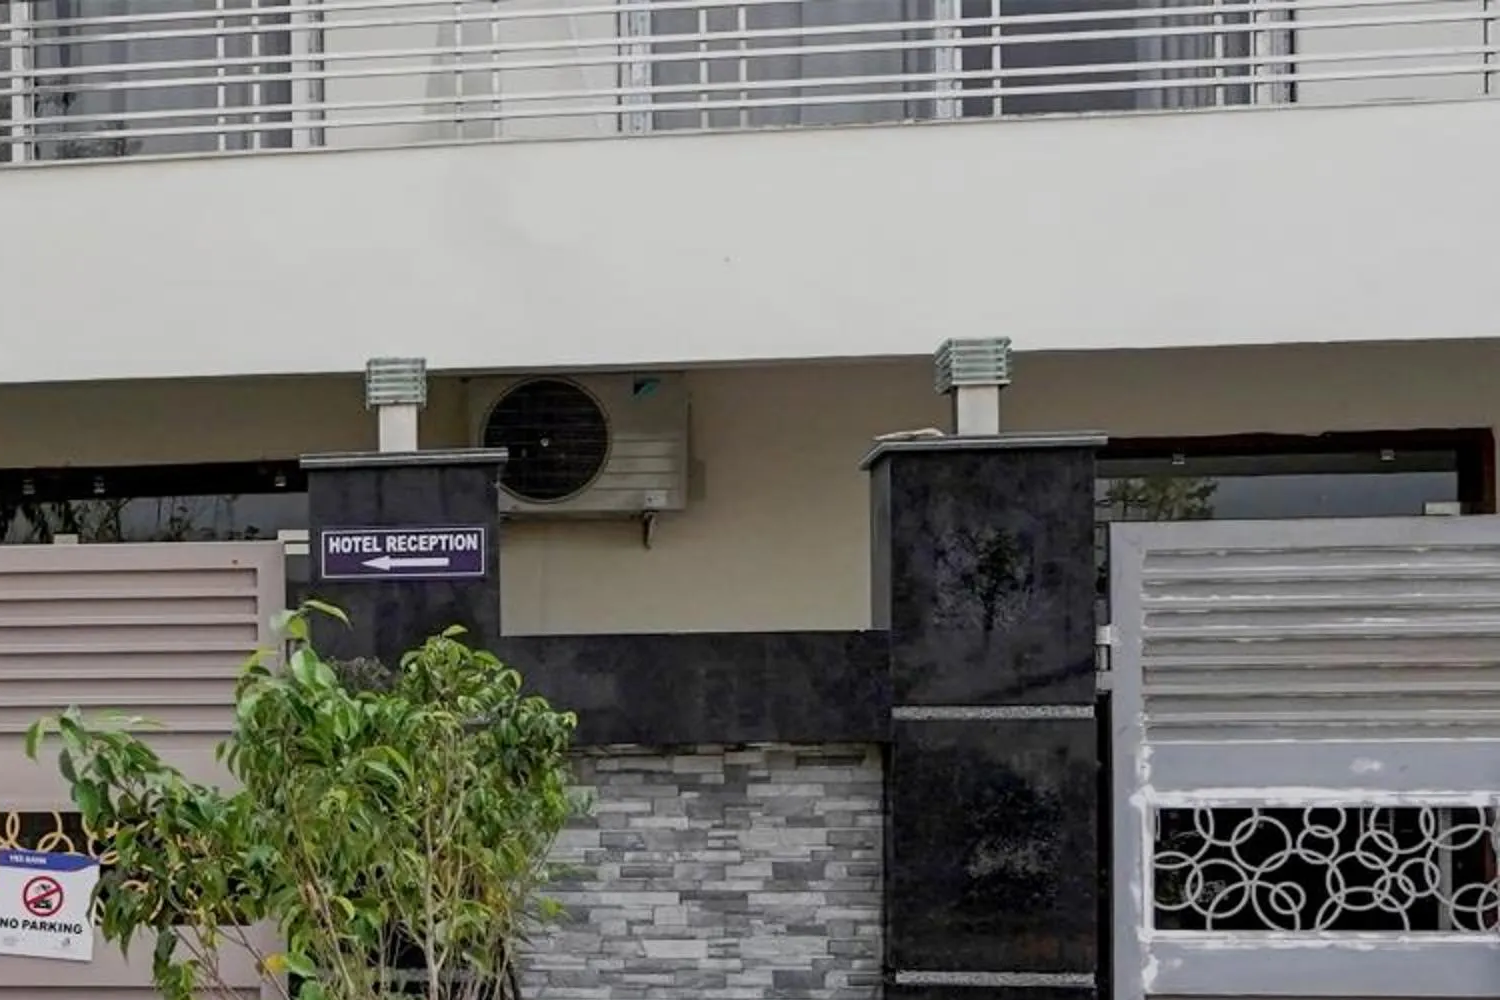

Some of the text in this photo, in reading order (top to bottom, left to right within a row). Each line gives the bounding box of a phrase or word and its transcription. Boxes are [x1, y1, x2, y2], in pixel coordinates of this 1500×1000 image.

[328, 533, 479, 554] HOTEL RECEPTION
[0, 917, 83, 935] NO PARKING
